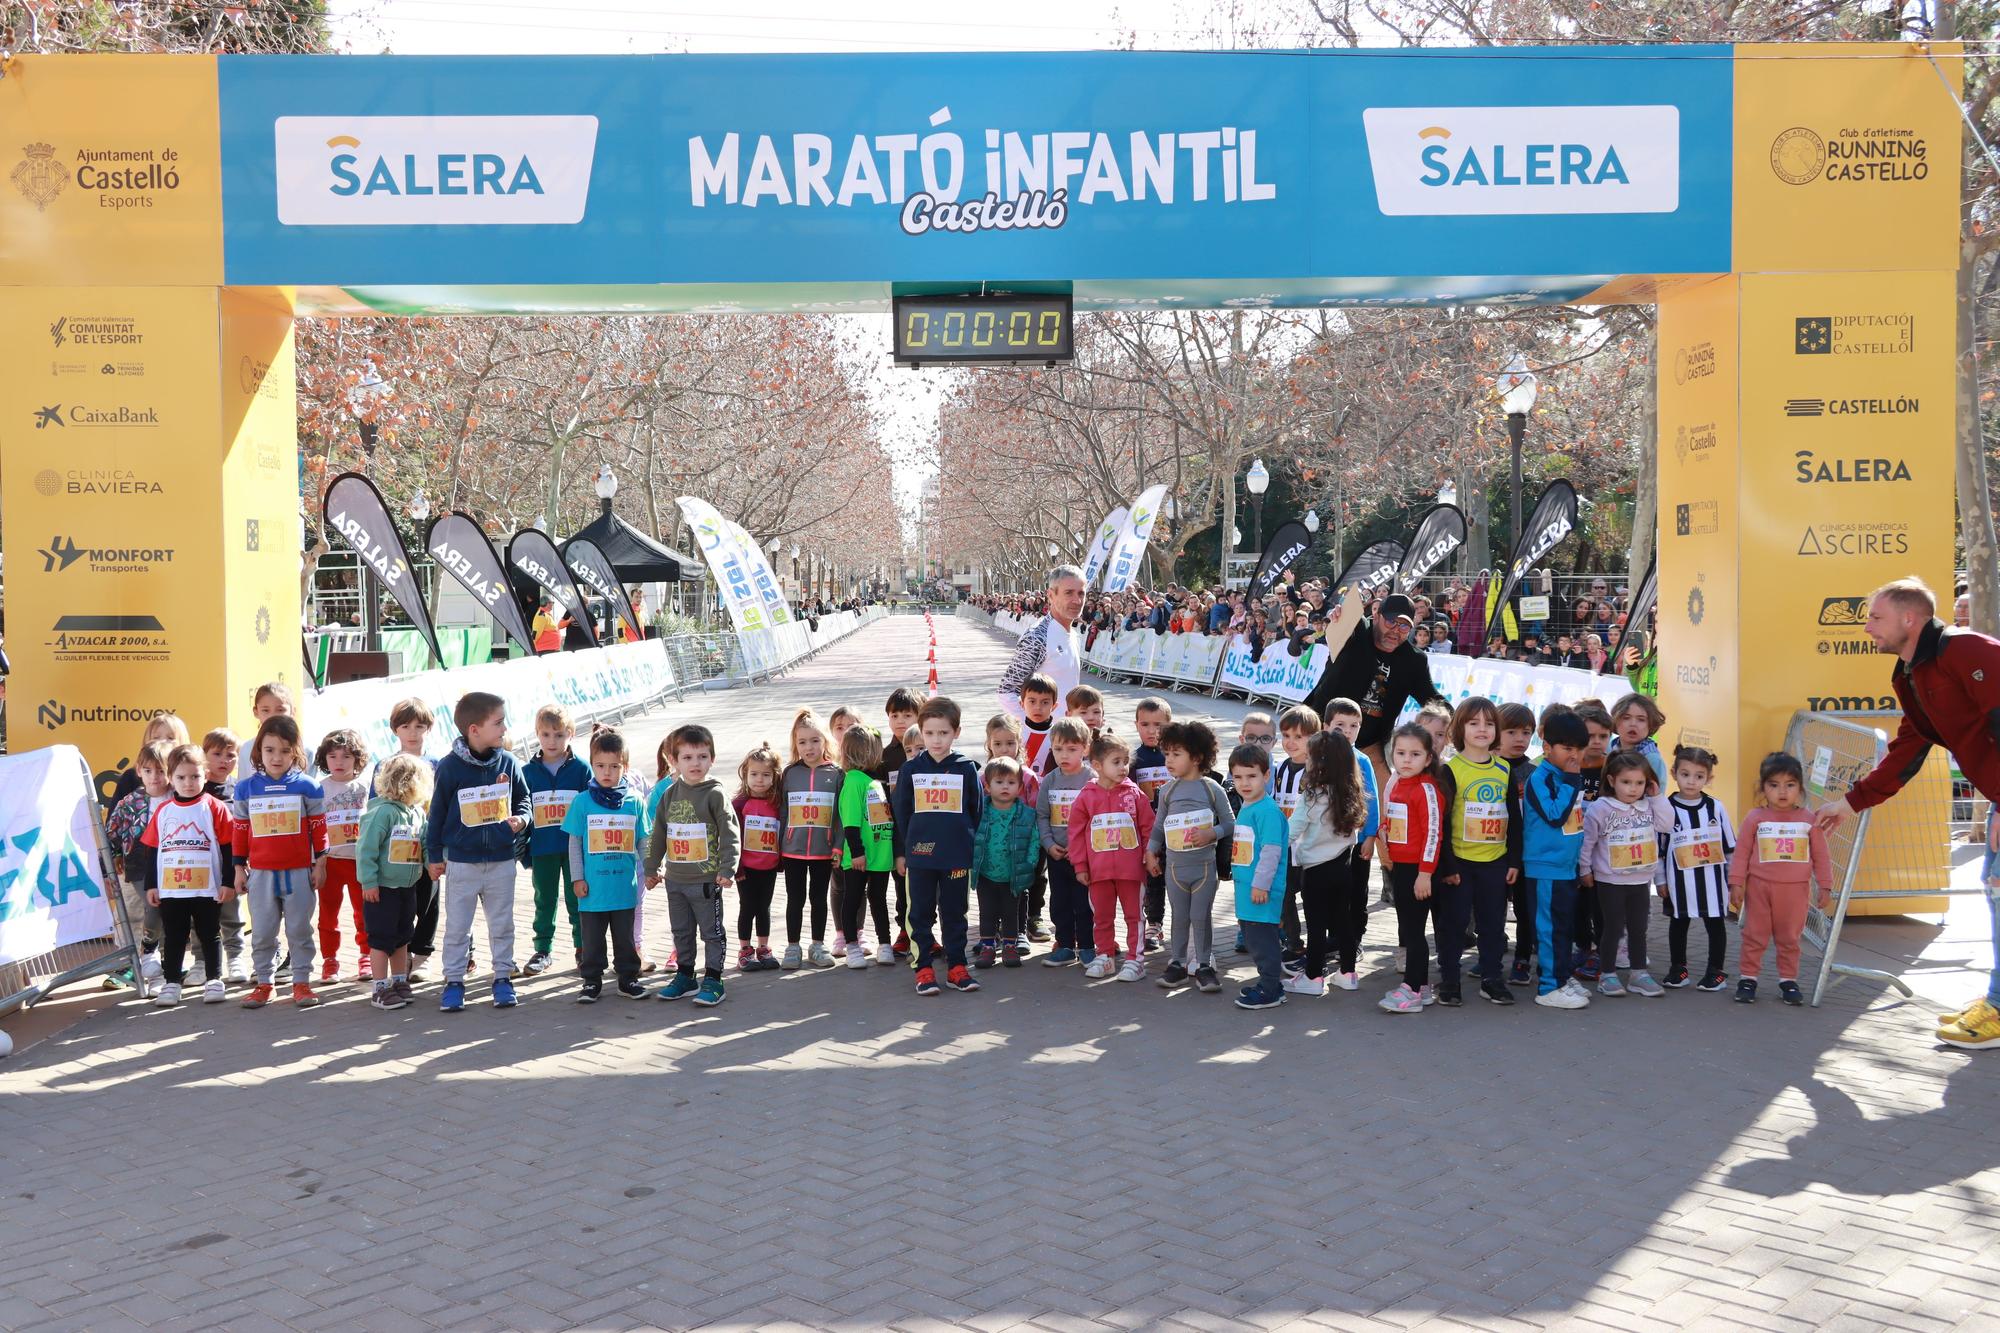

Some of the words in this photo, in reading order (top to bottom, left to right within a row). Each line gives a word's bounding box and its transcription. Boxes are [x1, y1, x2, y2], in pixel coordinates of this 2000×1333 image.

[1839, 128, 1859, 138] Club
[1863, 128, 1914, 138] d'atletisme
[76, 148, 154, 163] Ajuntament
[161, 148, 178, 161] de
[688, 106, 964, 207] MARATÓ
[1828, 140, 1927, 159] RUNNING
[1420, 144, 1631, 187] SALERA
[1826, 155, 1929, 181] CASTELLÓ
[76, 163, 180, 190] Castelló
[329, 153, 545, 196] SALERA
[99, 195, 153, 211] Esports
[901, 187, 1068, 236] Castelló
[1833, 313, 1909, 327] DIPUTACIÓ
[69, 323, 134, 333] COMUNITAT
[906, 311, 1061, 347] 0:00:00
[74, 334, 89, 344] DE
[92, 334, 144, 344] L'ESPORT
[1833, 340, 1909, 354] CASTELLÓ
[1829, 395, 1919, 414] CASTELLÓN
[70, 405, 159, 424] CaixaBank
[1689, 432, 1717, 451] Castelló
[1796, 459, 1912, 483] SALERA
[67, 482, 164, 494] BAVIERA
[88, 549, 175, 562] MONFORT
[1401, 533, 1461, 592] SALERA
[90, 563, 149, 573] Transportes
[1260, 541, 1306, 588] SALERA
[55, 632, 117, 650] ANDACAR
[120, 636, 151, 648] 2000,
[153, 638, 169, 646] S.A.
[1833, 640, 1878, 655] YAMAH
[924, 788, 949, 804] 120
[543, 804, 566, 819] 106
[801, 805, 819, 820] 80
[262, 812, 287, 828] 164
[1480, 819, 1501, 834] 123
[604, 829, 623, 844] 90
[760, 831, 776, 845] 48
[672, 840, 690, 854] 69
[1629, 844, 1643, 859] 11
[1693, 844, 1711, 858] 43
[1775, 838, 1795, 853] 25
[173, 868, 192, 882] 54
